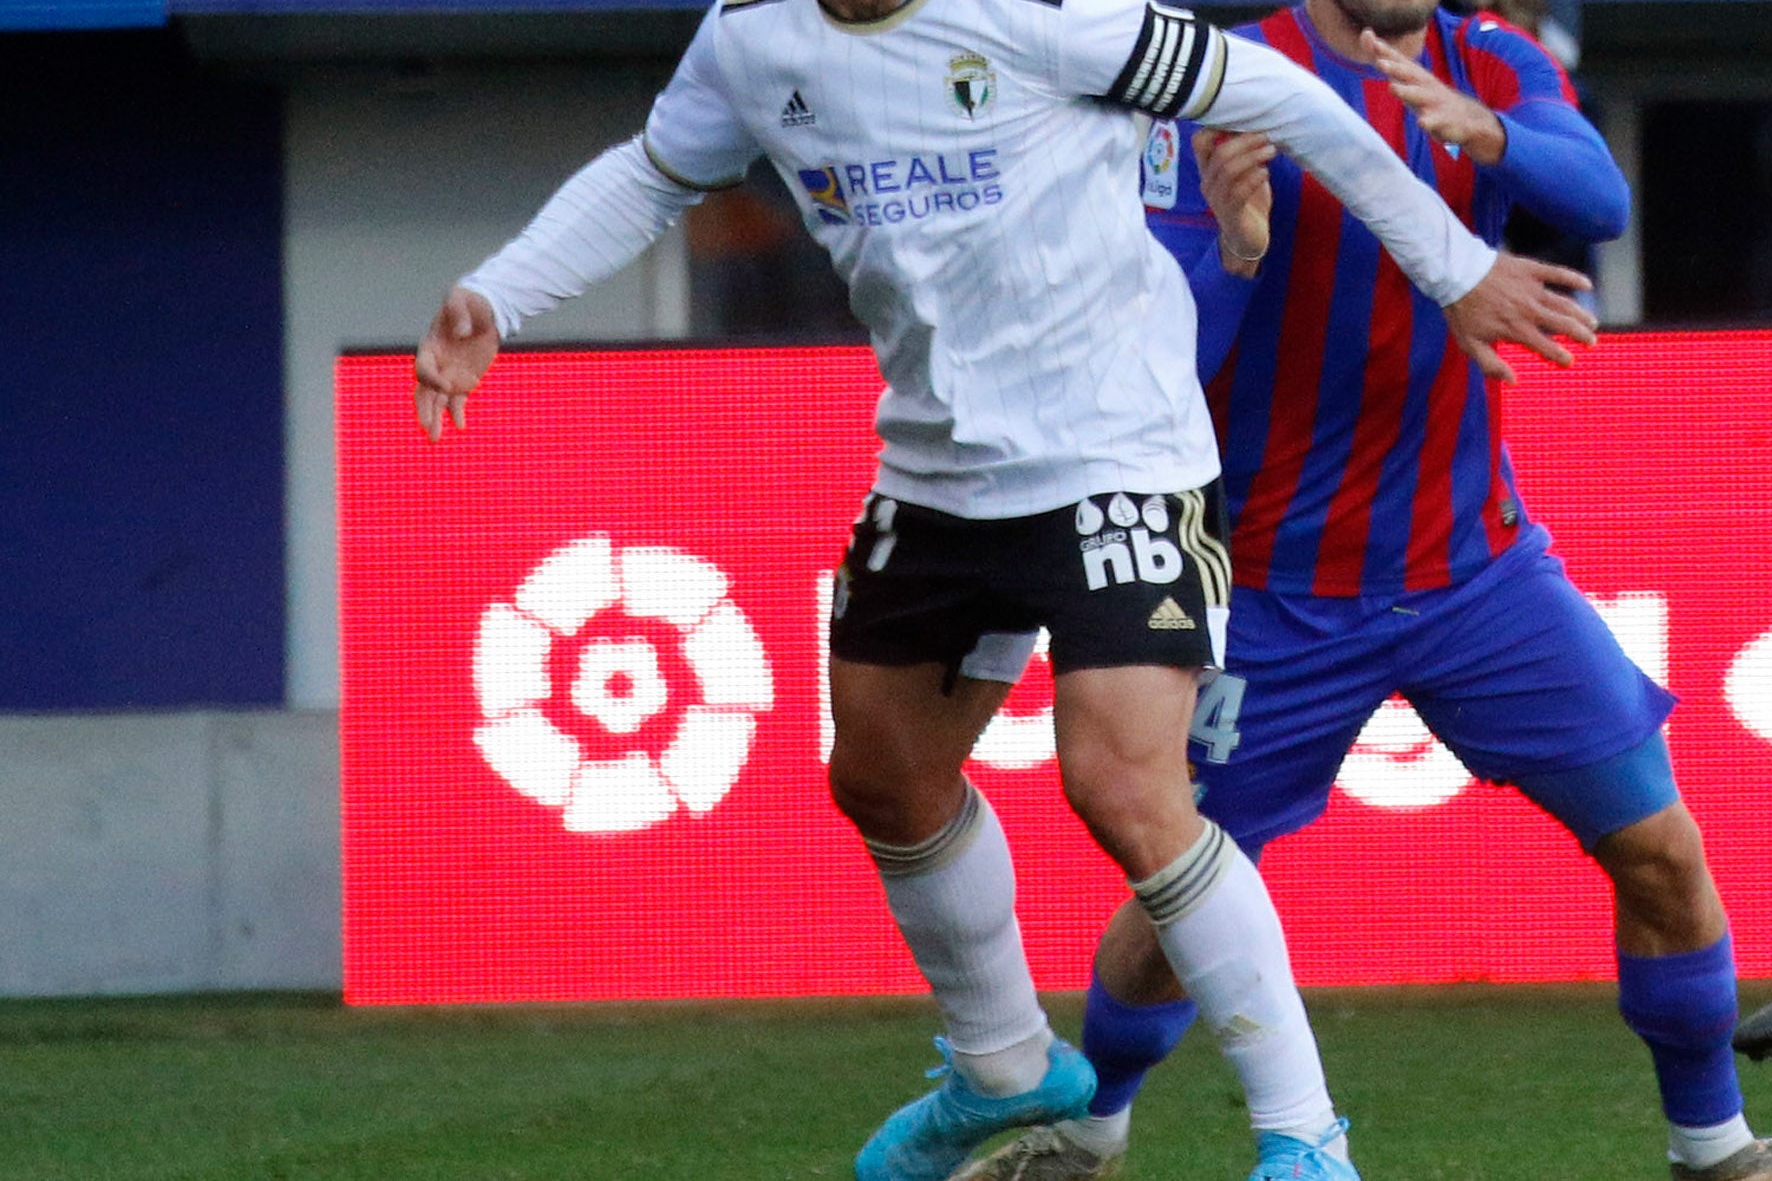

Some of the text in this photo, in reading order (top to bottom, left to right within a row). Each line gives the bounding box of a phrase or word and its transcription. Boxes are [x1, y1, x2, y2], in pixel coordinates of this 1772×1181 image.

[845, 149, 1000, 195] REALE
[854, 185, 1003, 227] SEGUROS
[1082, 526, 1184, 591] nb
[1187, 672, 1247, 764] 4
